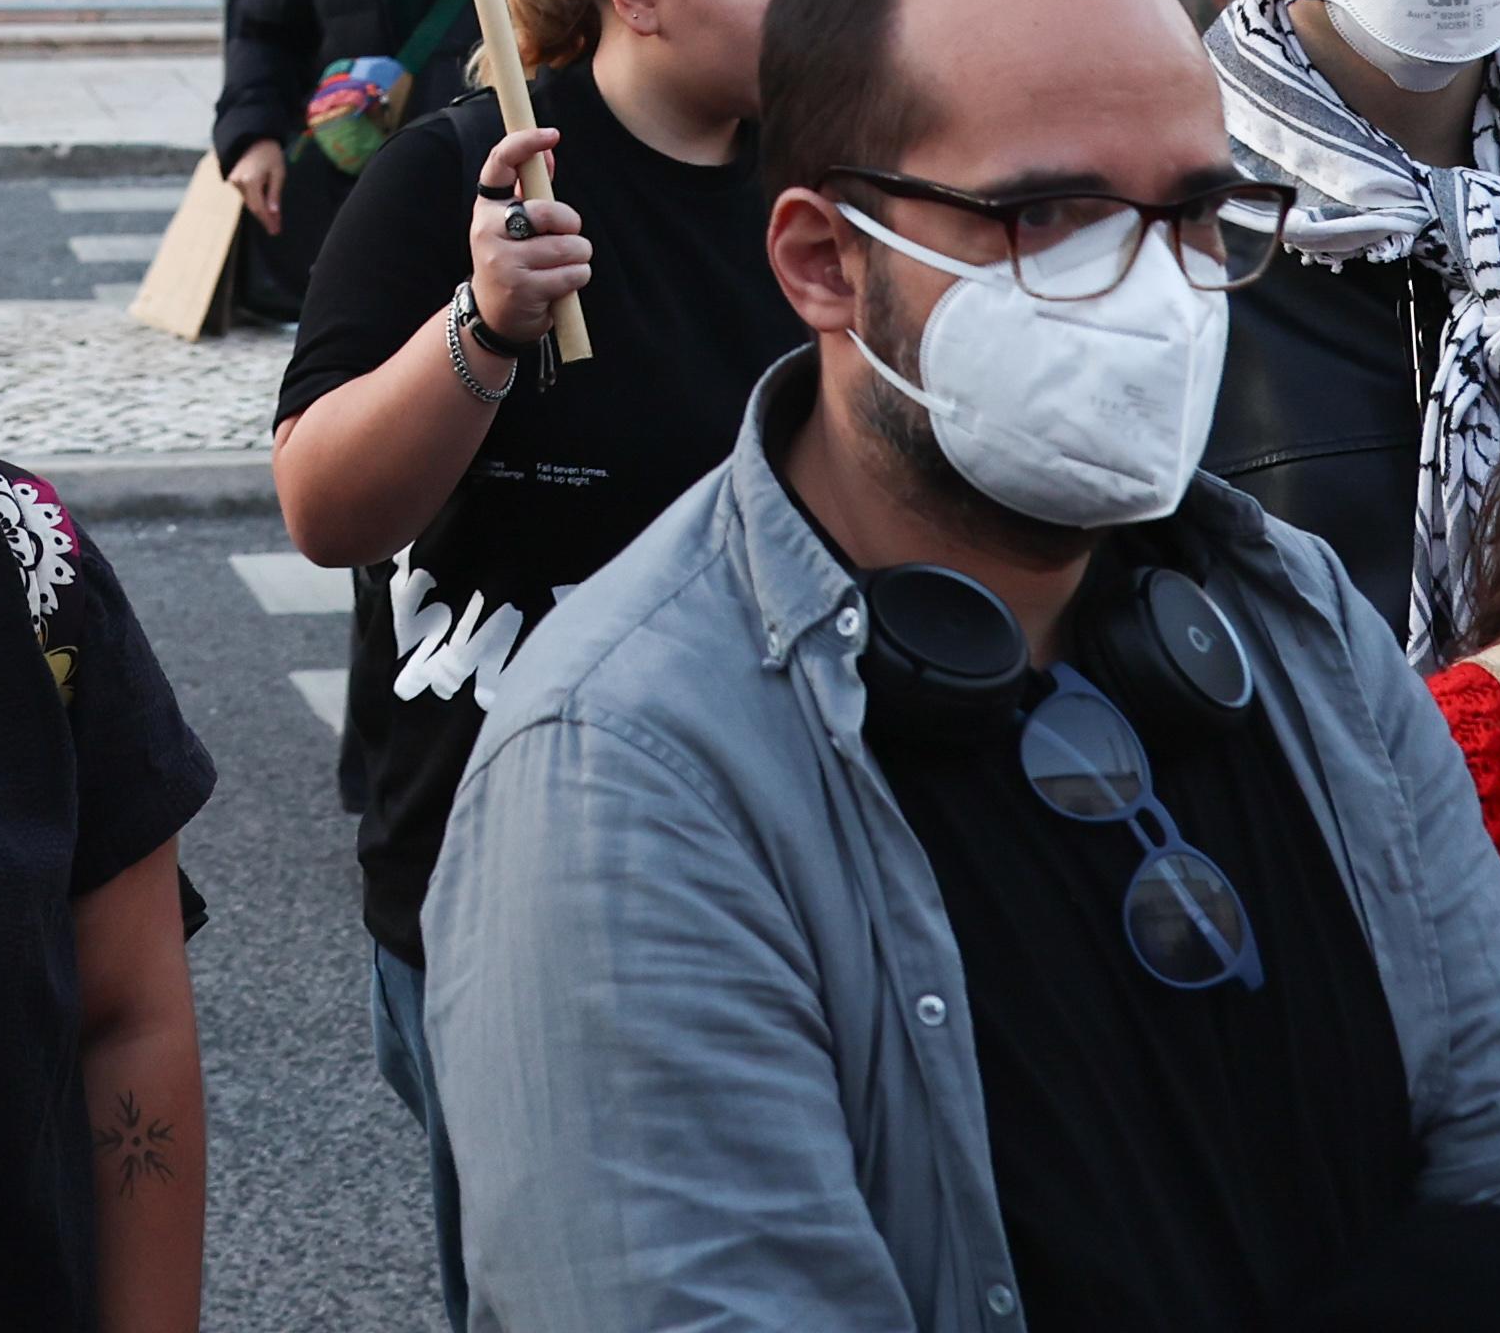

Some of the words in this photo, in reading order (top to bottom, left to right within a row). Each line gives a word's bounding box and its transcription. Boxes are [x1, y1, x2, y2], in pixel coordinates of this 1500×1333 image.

[1436, 21, 1470, 30] NIOSH
[536, 462, 552, 473] Fall
[553, 465, 580, 475] seven
[554, 475, 566, 484] up
